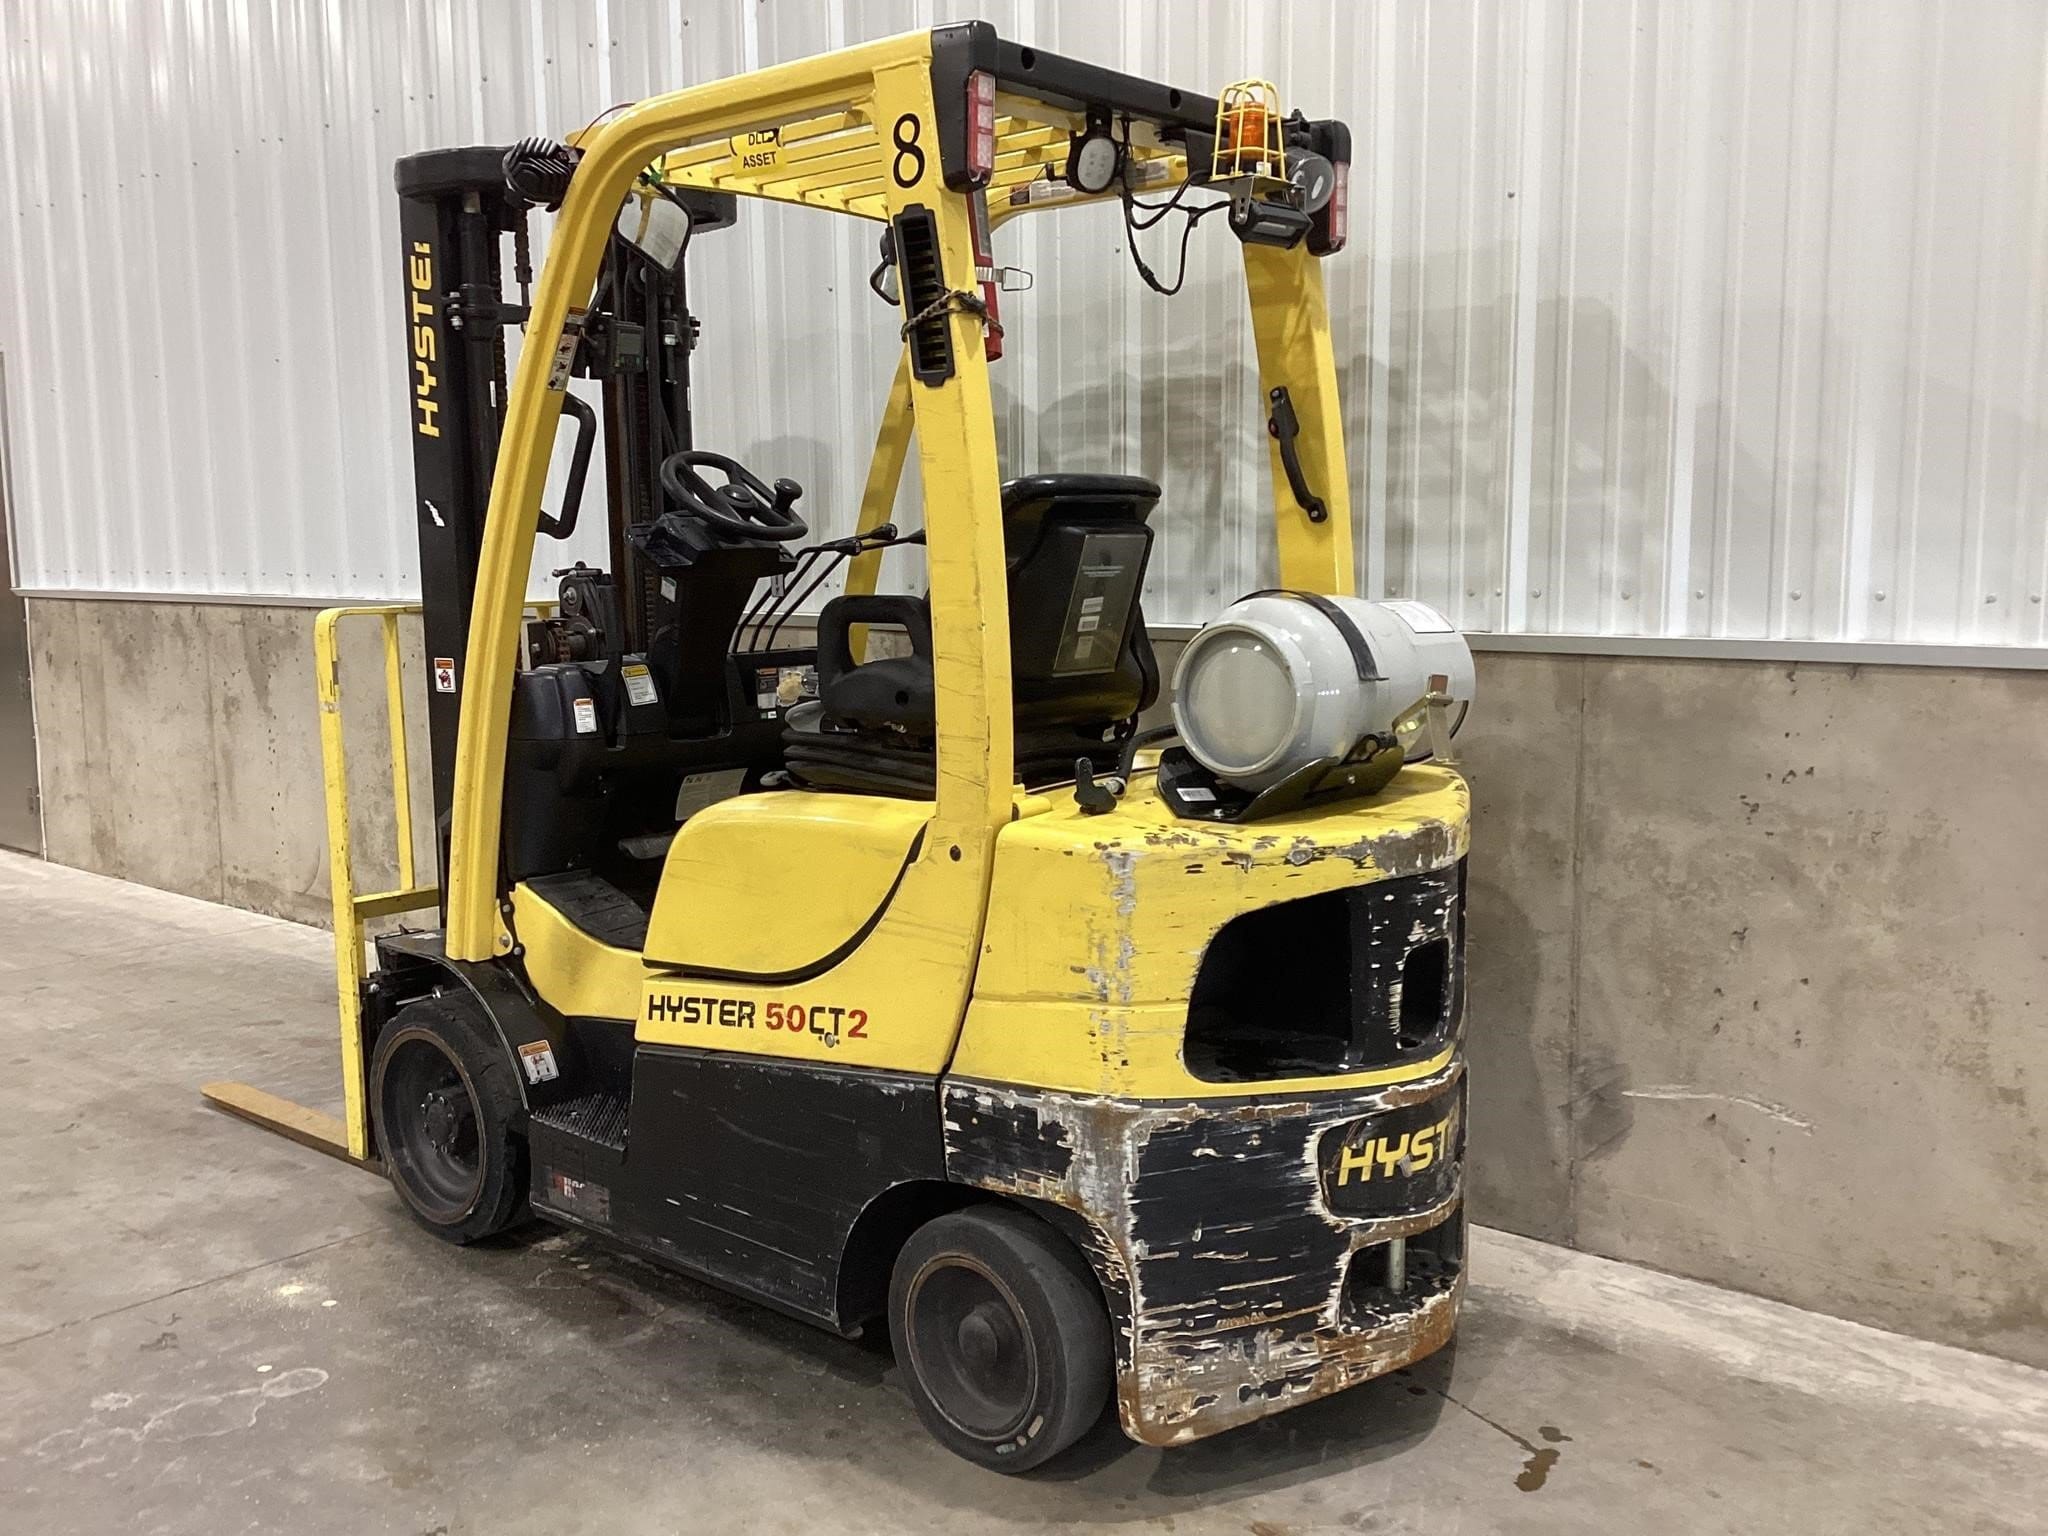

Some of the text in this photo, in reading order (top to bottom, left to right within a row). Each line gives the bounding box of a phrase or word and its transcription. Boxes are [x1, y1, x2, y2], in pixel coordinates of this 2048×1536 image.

[743, 151, 777, 168] ASSET
[893, 113, 926, 189] 8
[648, 994, 756, 1028] HYSTER
[1338, 1116, 1452, 1186] HYST
